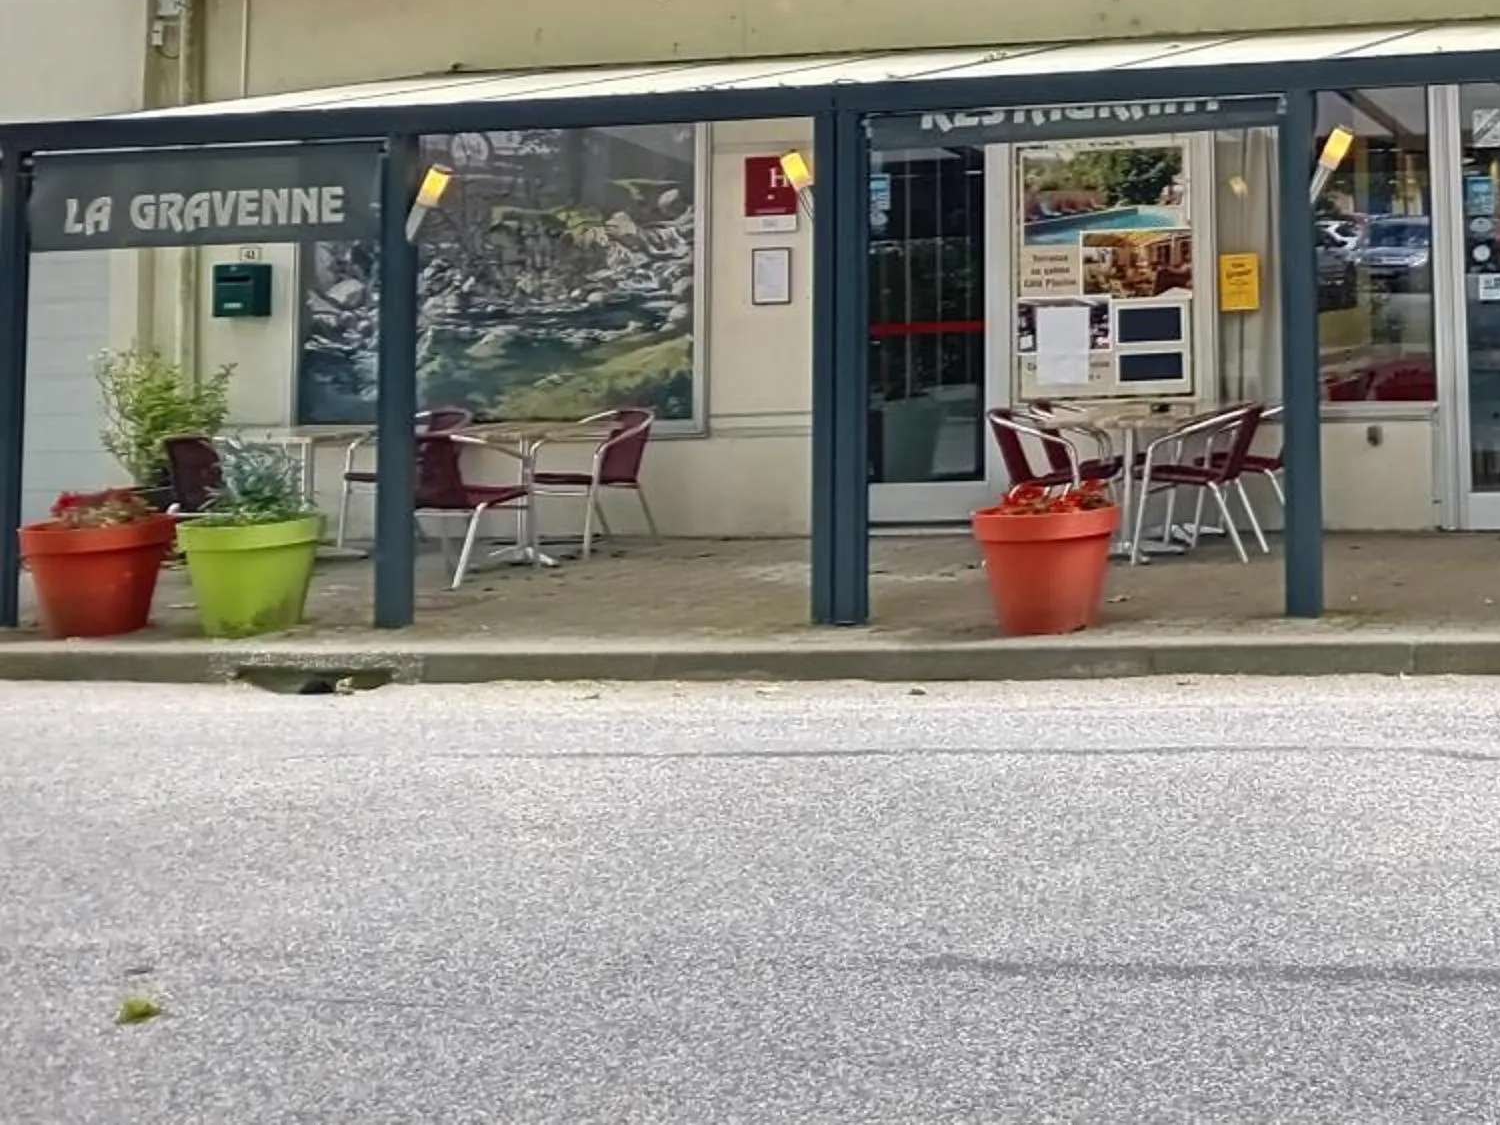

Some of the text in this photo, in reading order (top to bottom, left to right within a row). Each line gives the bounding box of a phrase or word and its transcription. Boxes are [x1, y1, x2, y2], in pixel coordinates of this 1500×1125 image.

[769, 167, 790, 188] H
[63, 186, 346, 236] LA GRAVENNE
